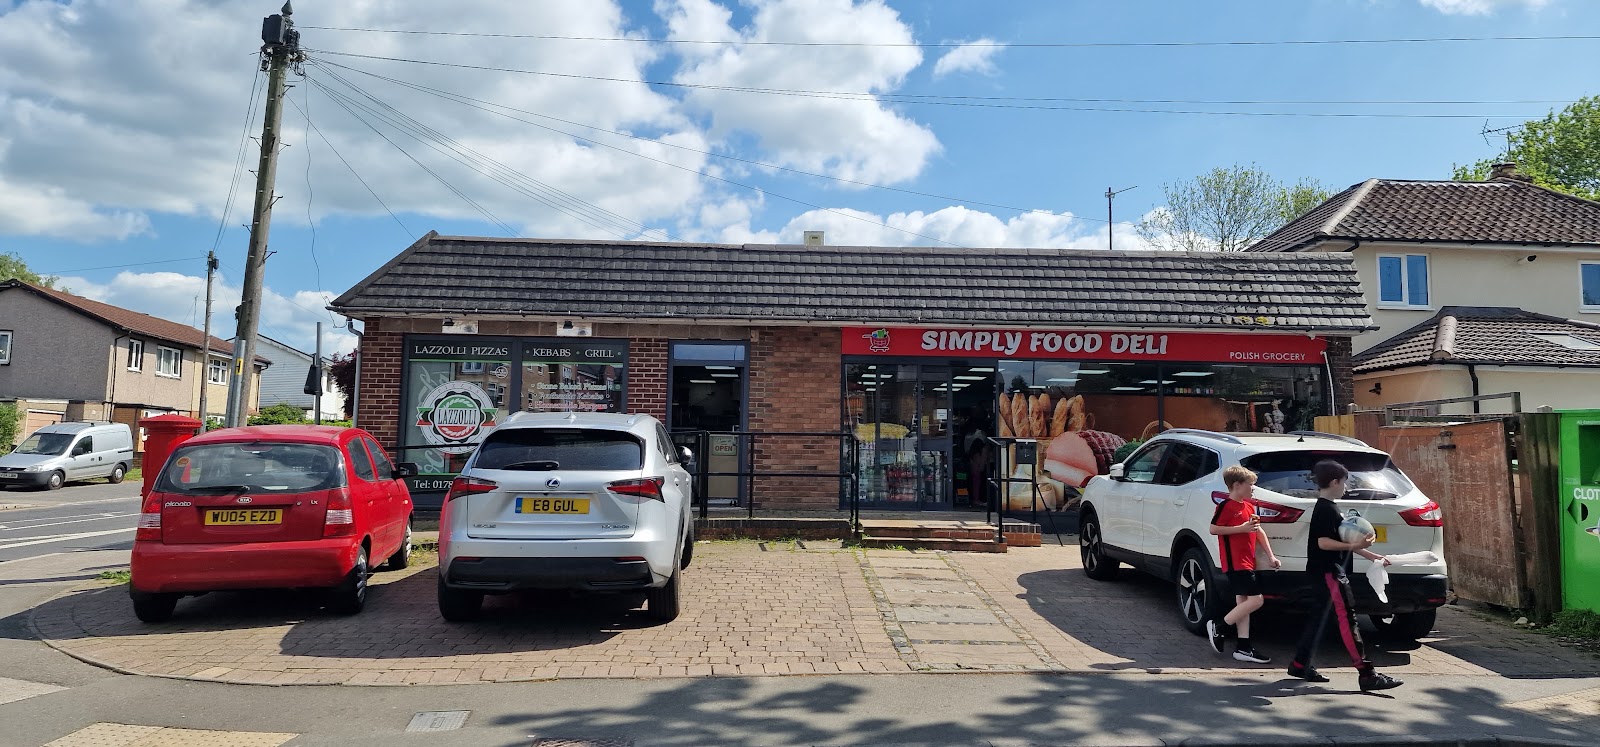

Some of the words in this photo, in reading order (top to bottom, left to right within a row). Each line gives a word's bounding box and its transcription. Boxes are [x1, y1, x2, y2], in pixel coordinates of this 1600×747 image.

[921, 330, 1022, 355] SIMPLY
[1029, 332, 1103, 354] FOOD
[1110, 334, 1168, 355] DELI
[414, 345, 467, 355] LAZZOLLI
[471, 346, 508, 356] PIZZAS
[532, 348, 571, 357] KEBABS
[584, 349, 615, 358] GRILL
[1229, 351, 1260, 360] POLISH
[1262, 352, 1306, 361] GROCERY
[437, 409, 477, 425] LAZZOLLI
[413, 480, 431, 489] Tel:
[164, 501, 192, 509] picanto
[533, 500, 550, 511] E8
[553, 500, 579, 512] GUL
[212, 510, 246, 523] WU05
[250, 510, 276, 522] EZD
